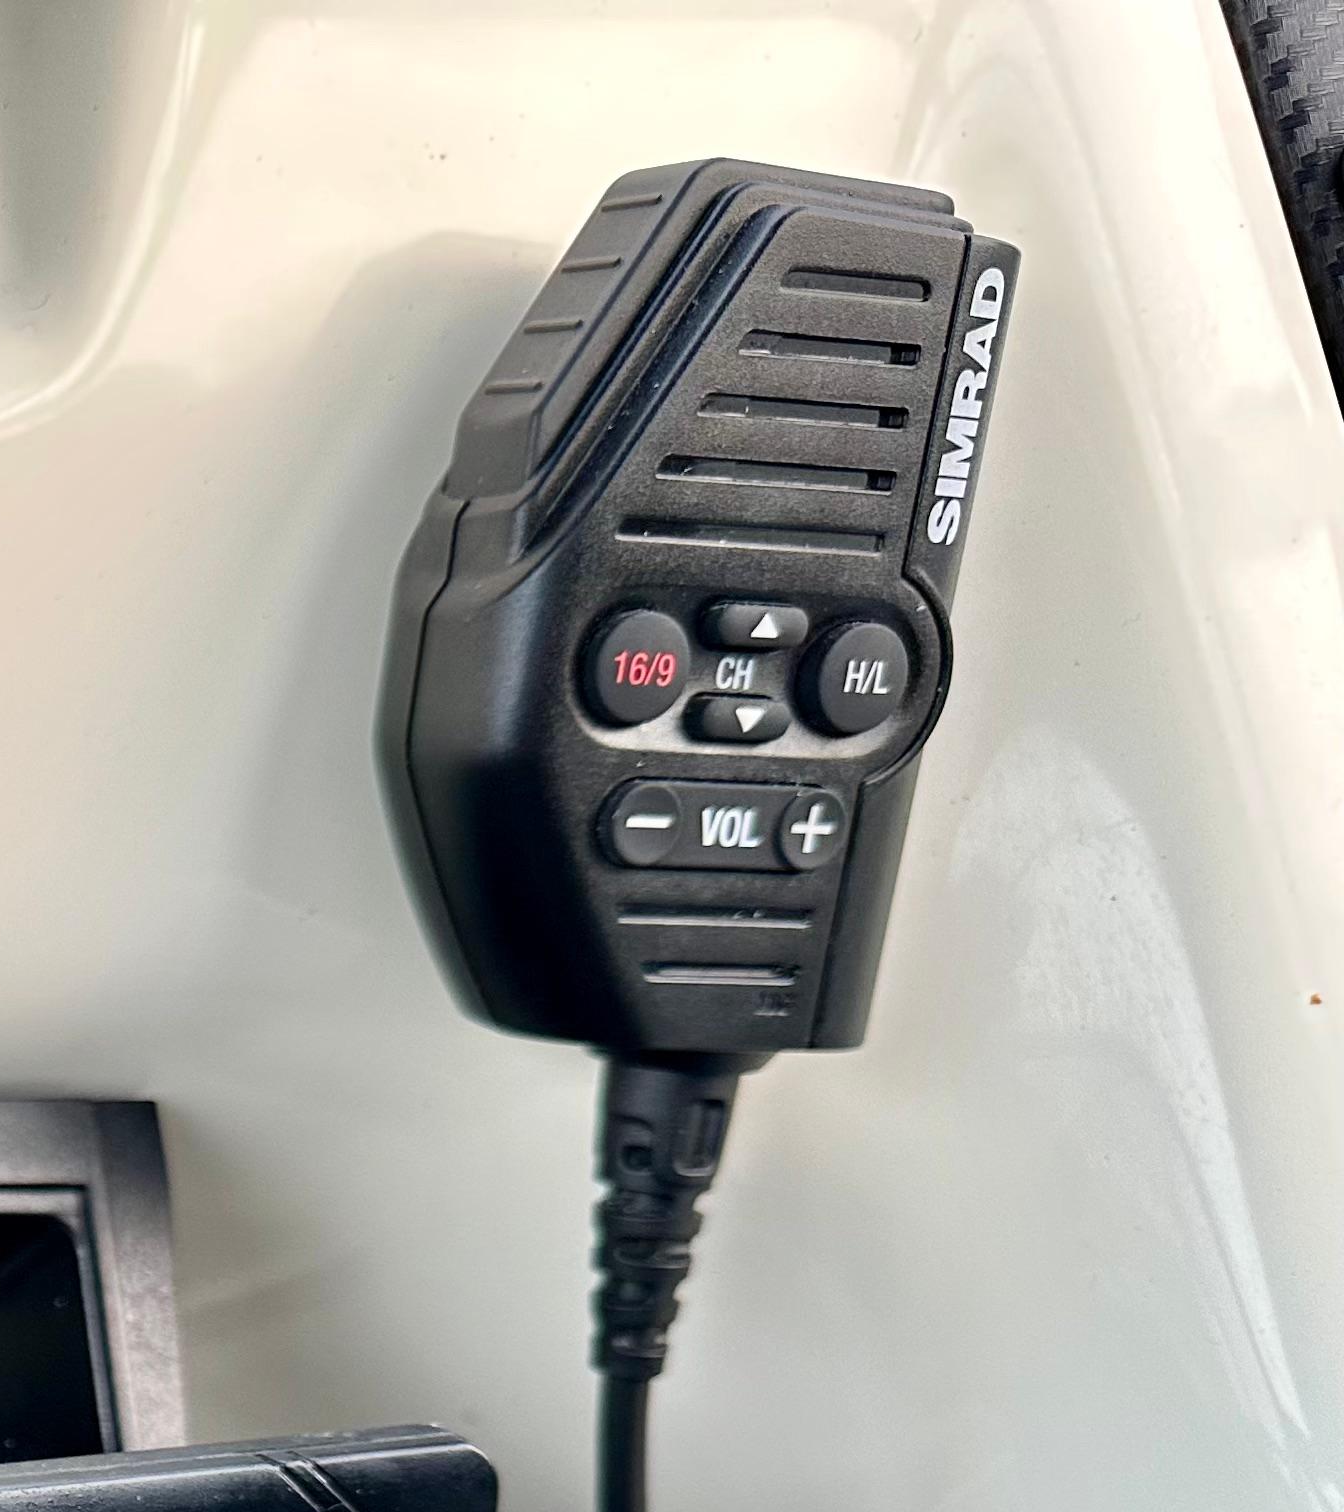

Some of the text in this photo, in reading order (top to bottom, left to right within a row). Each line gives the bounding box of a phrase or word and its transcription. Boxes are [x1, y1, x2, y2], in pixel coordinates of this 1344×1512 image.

[927, 267, 1005, 546] SIMRAD
[616, 651, 677, 686] 16/9
[715, 657, 754, 693] CH
[843, 658, 891, 695] H/L
[701, 807, 762, 848] VOL
